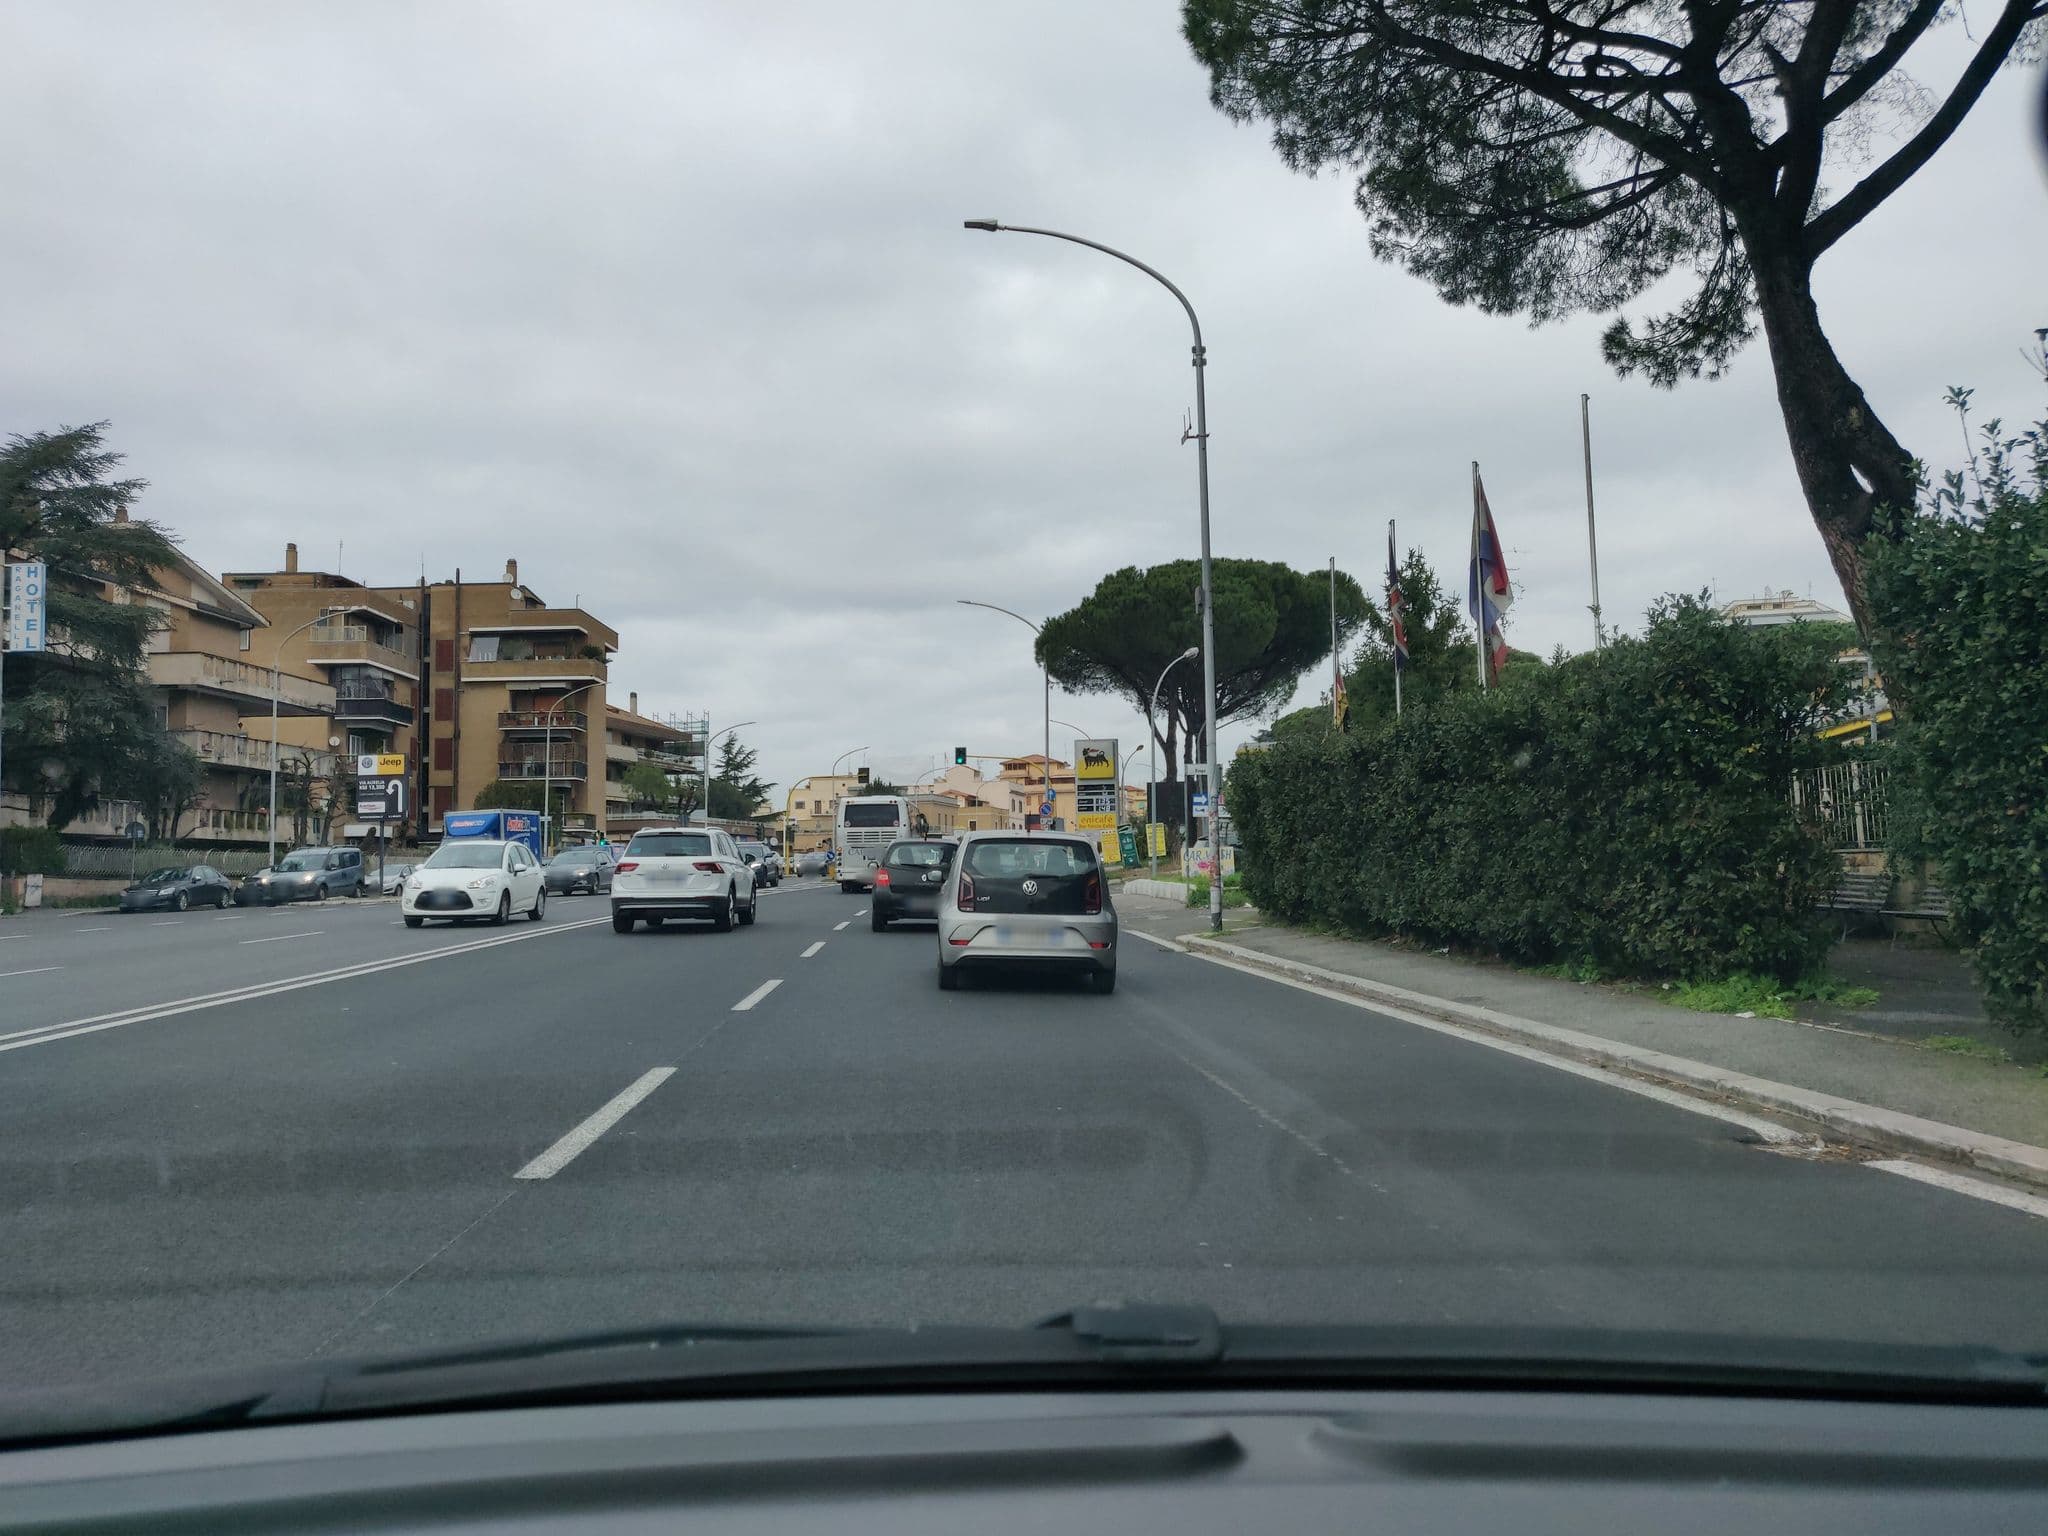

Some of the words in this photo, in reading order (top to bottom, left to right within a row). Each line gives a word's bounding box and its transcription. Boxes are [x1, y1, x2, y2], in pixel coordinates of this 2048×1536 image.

[25, 566, 39, 649] HOTEL
[379, 758, 402, 768] Jeep
[1184, 850, 1202, 862] CAR
